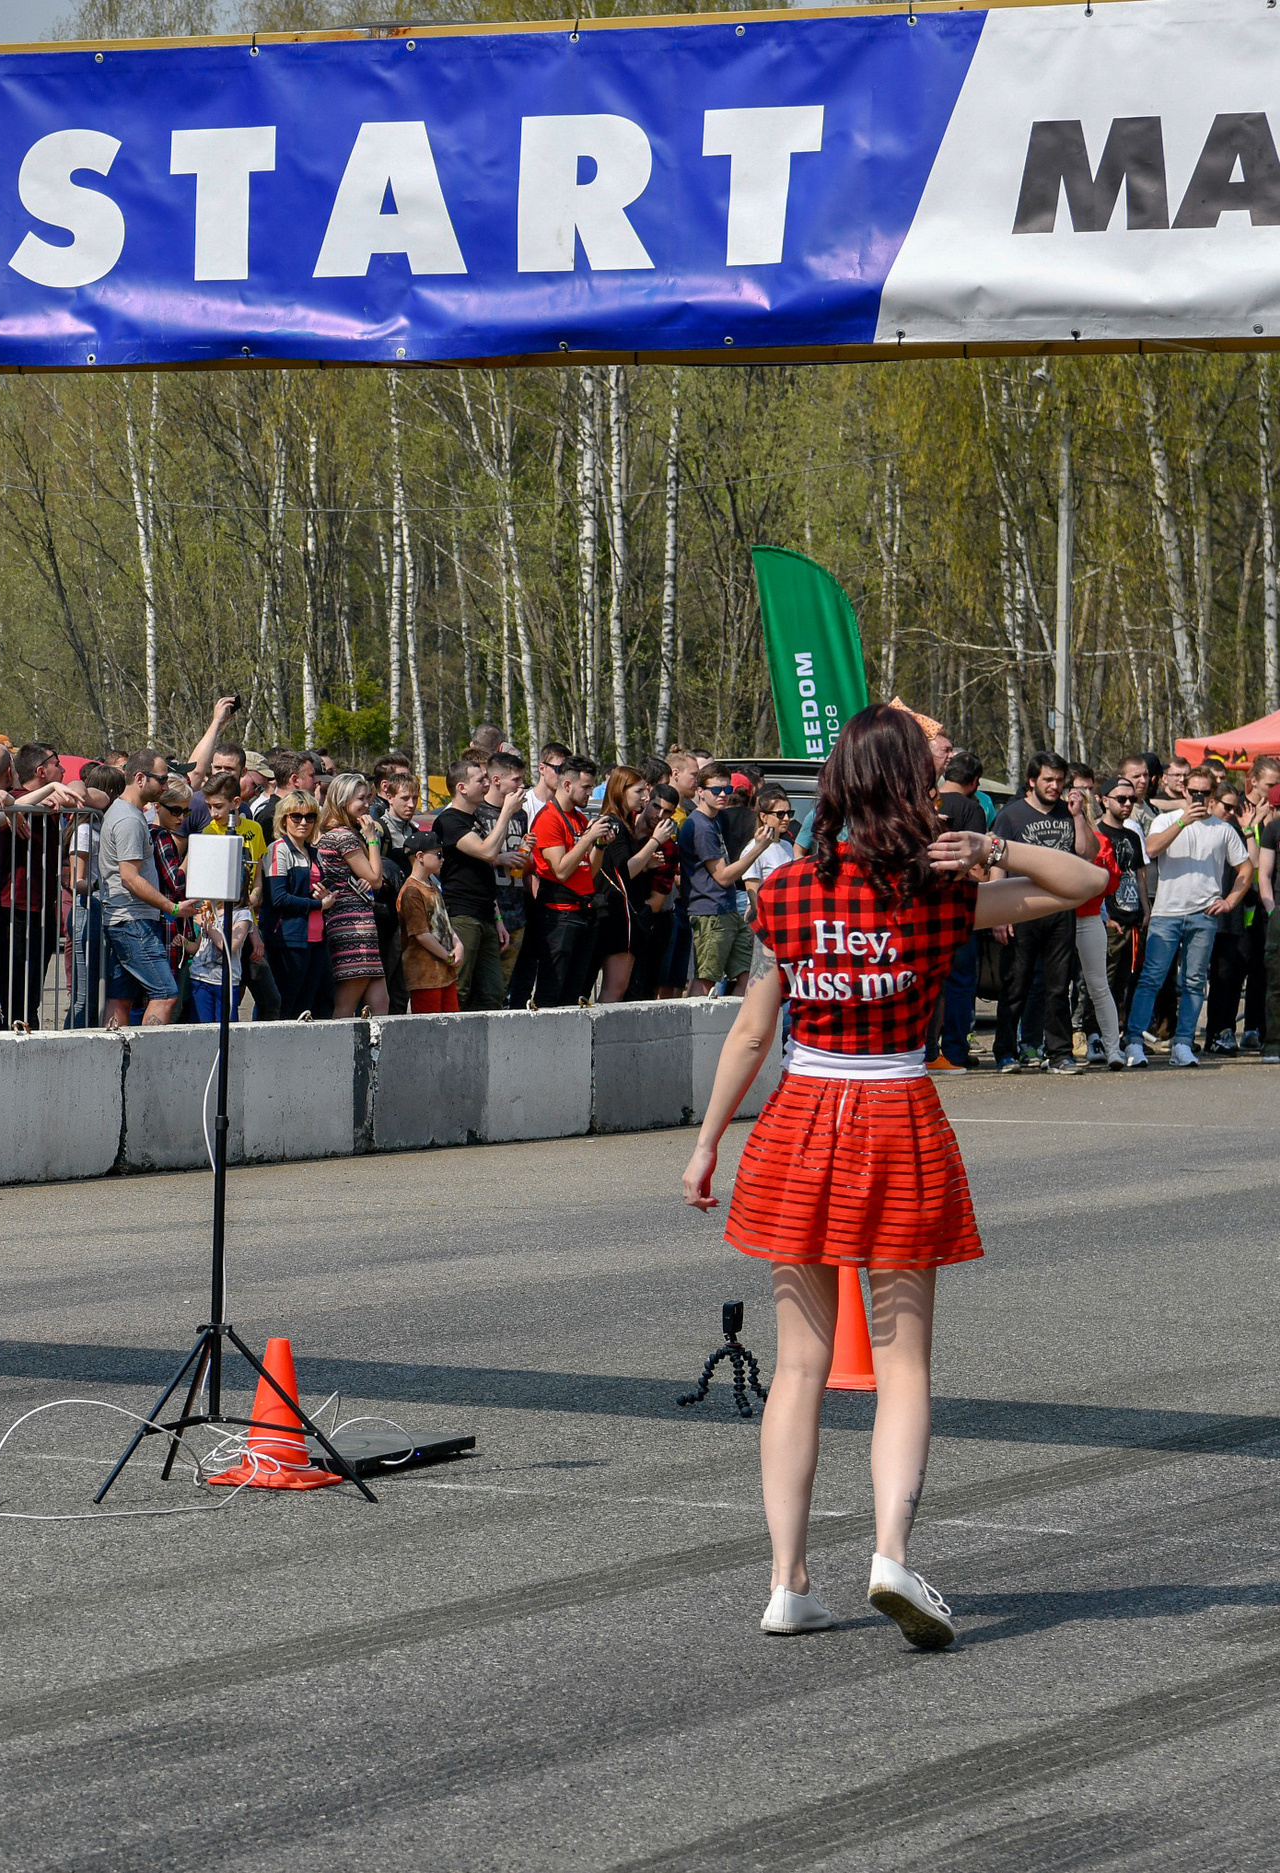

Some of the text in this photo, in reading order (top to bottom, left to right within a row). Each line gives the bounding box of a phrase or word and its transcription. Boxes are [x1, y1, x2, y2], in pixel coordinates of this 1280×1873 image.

[7, 105, 826, 288] START
[793, 651, 824, 761] EEDOM
[824, 704, 841, 760] nce
[1025, 819, 1052, 832] MOTO
[813, 919, 898, 964] Hey,
[780, 958, 853, 1001] Kiss
